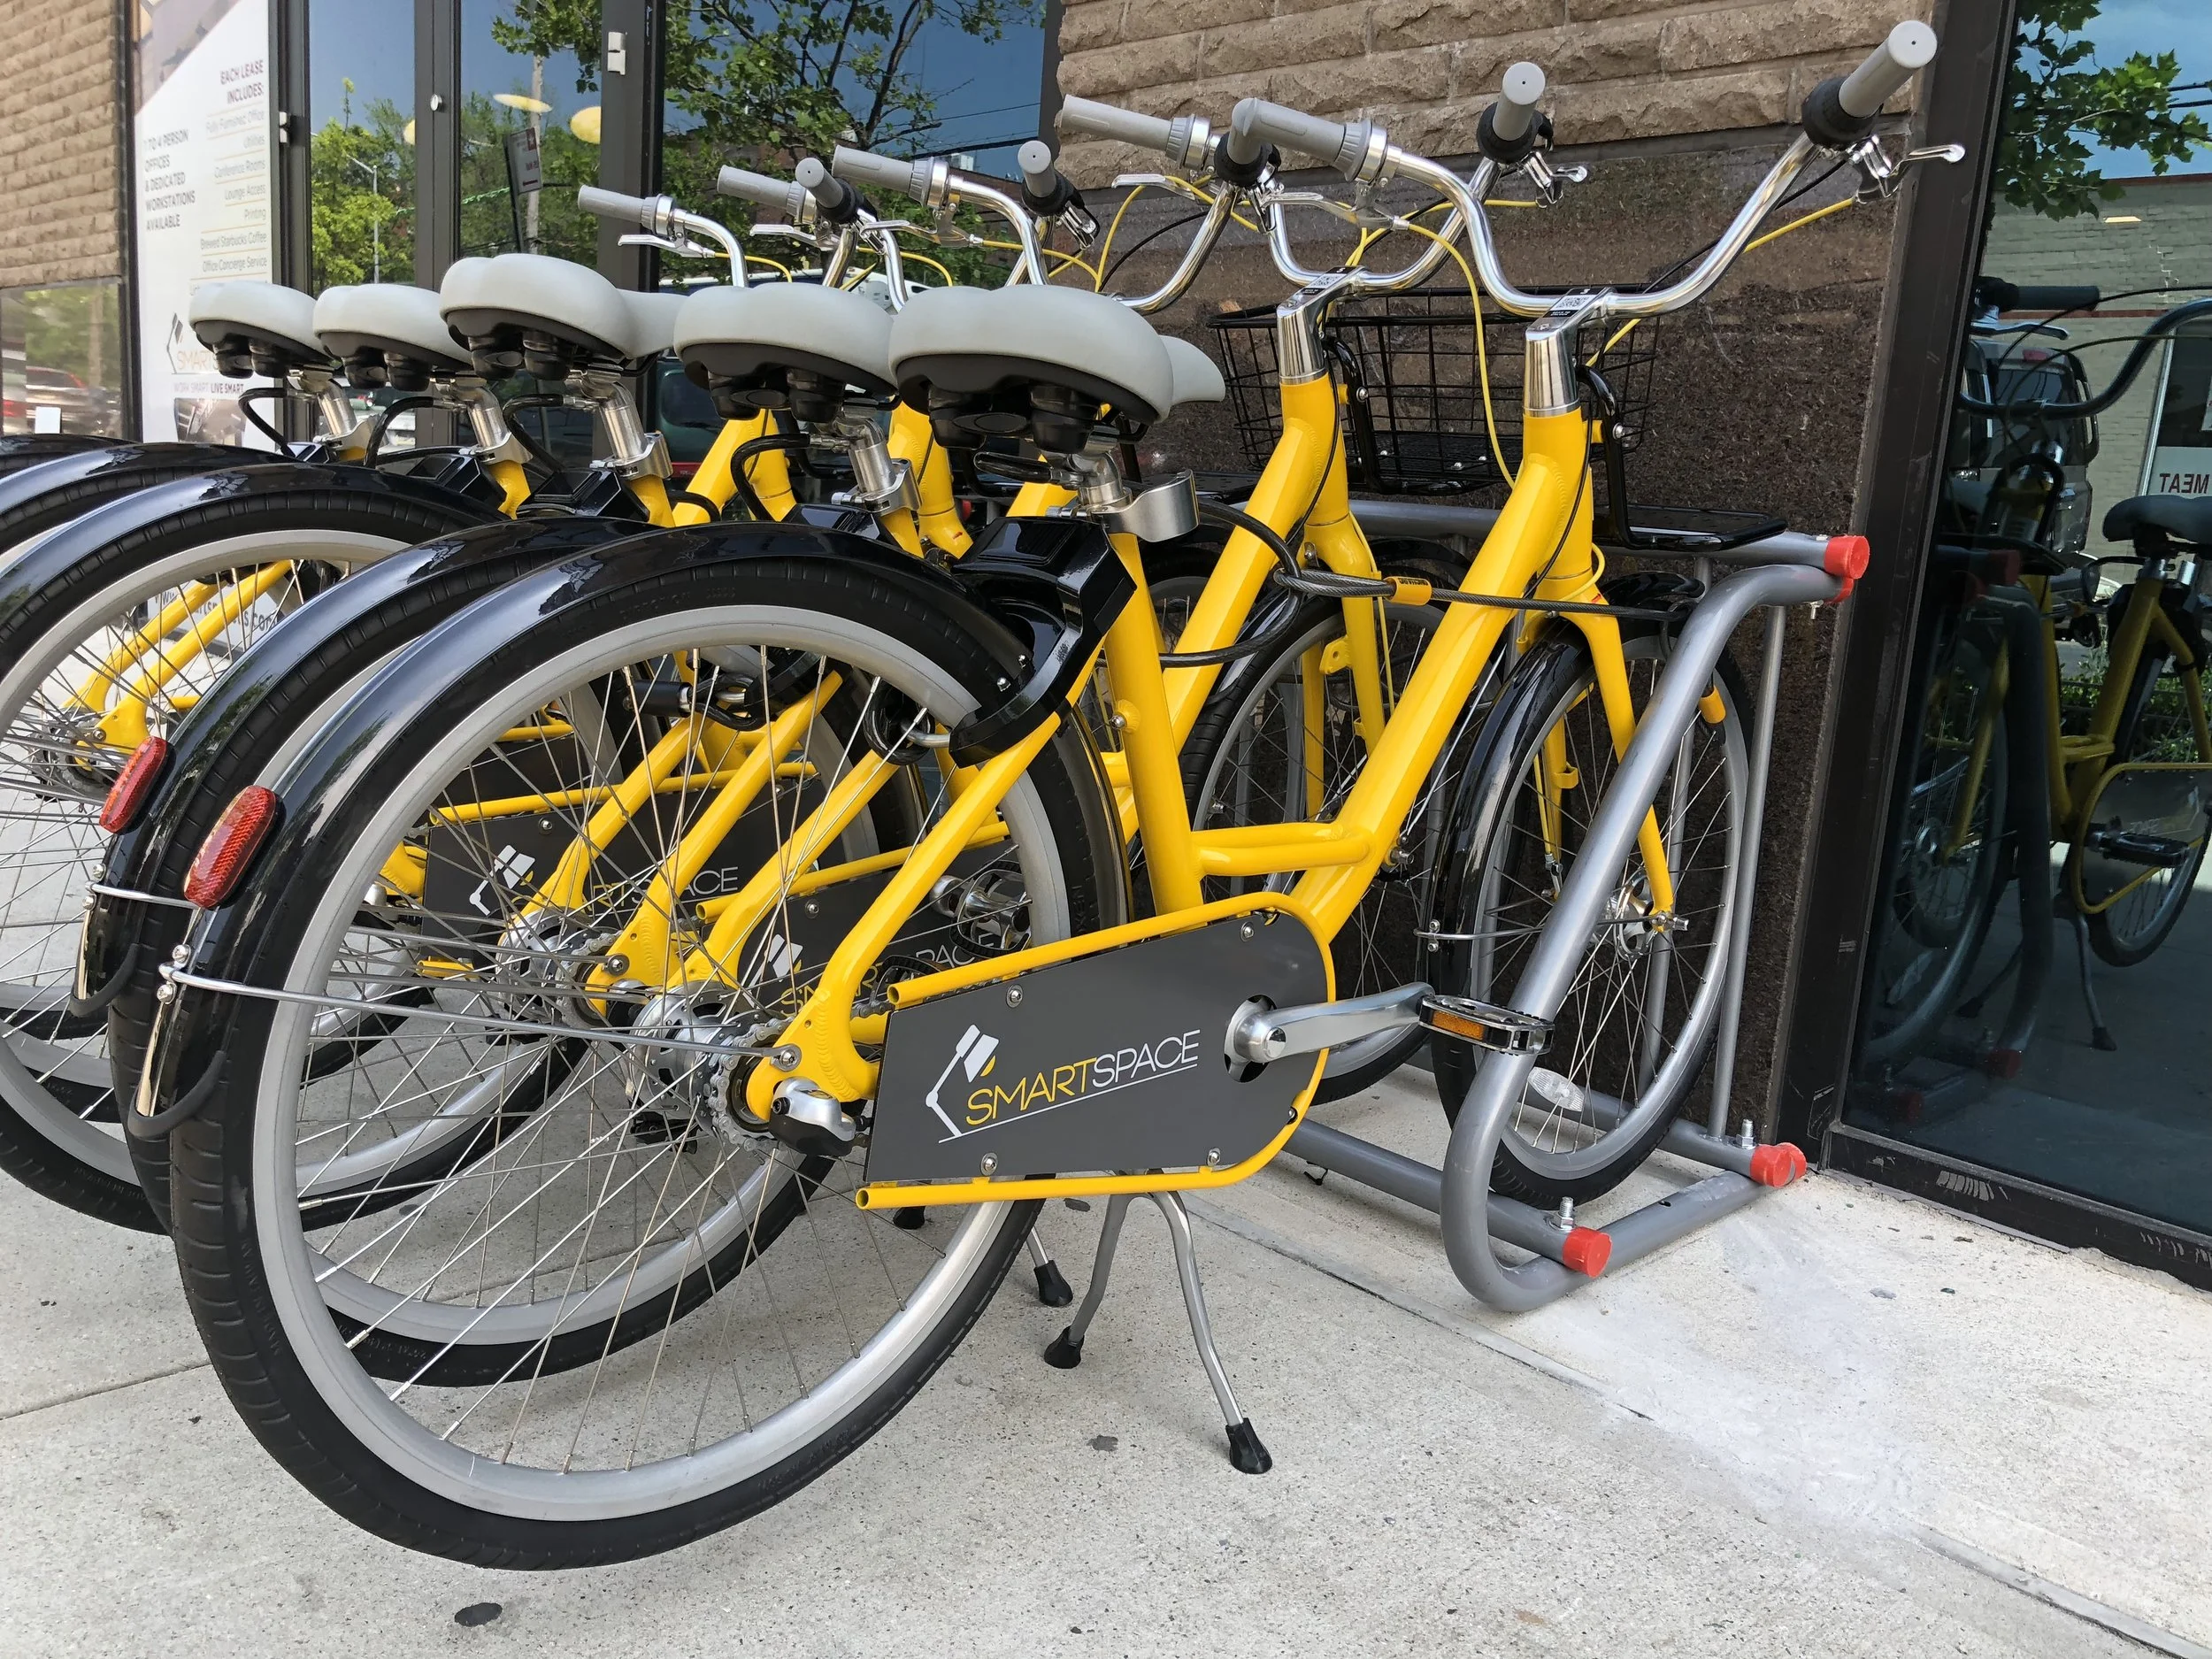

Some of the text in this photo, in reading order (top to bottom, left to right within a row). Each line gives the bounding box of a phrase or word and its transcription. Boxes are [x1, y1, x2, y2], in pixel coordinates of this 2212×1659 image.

[221, 59, 264, 85] EACH LEASE
[227, 82, 265, 104] INCLUDES:
[164, 129, 188, 147] PERSON
[144, 154, 170, 173] OFFICES
[214, 159, 266, 178] Conference Rooms
[150, 172, 186, 191] DEDICATED
[145, 189, 196, 212] WORKSTATIONS
[225, 184, 266, 201] Lounge Access
[146, 213, 180, 231] AVAILABLE
[244, 208, 266, 221] Printing
[201, 231, 267, 250] Brewed Starbucks Coffee
[203, 256, 268, 272] Office Concierge Service
[211, 382, 224, 395] LIVE
[224, 383, 244, 395] SMART
[965, 1029, 1201, 1125] SMARTSPACE
